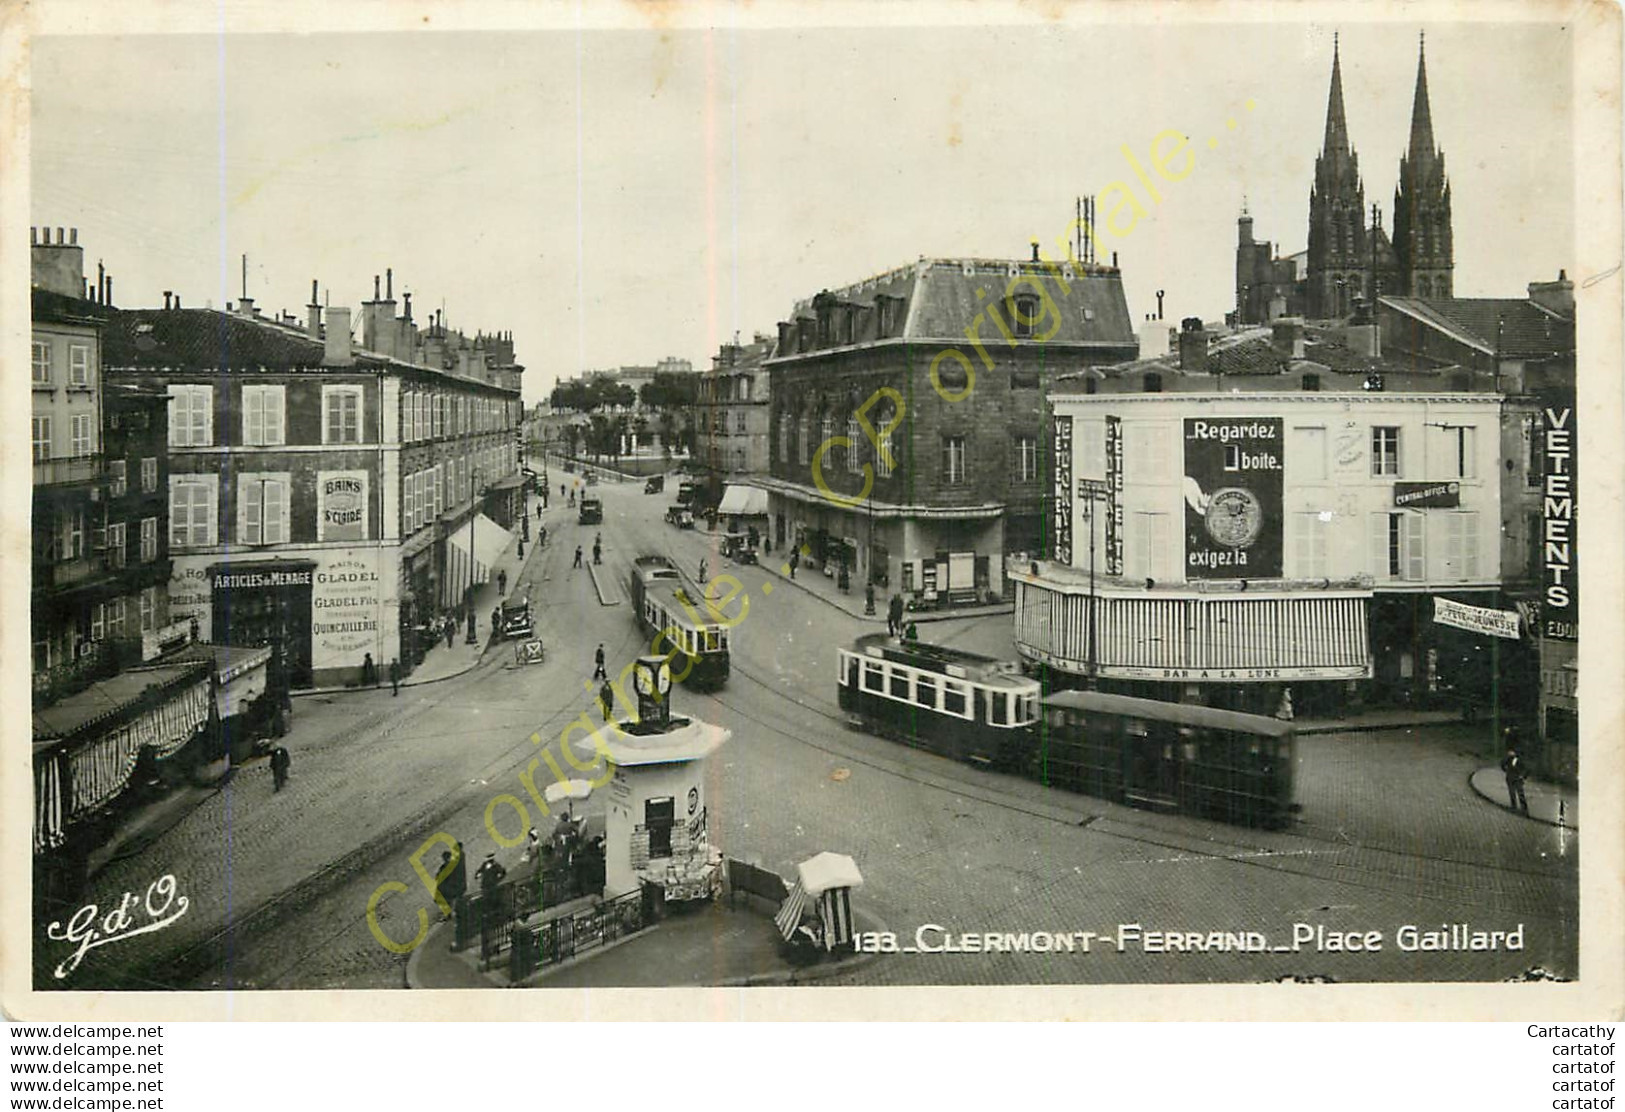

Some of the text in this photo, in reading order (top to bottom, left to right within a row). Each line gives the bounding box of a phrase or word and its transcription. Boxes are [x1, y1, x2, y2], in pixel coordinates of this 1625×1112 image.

[326, 480, 361, 495] BAINS
[1545, 408, 1571, 607] VETEMENTS
[1189, 549, 1247, 568] exigez la
[214, 574, 263, 589] ARTICLES
[271, 571, 311, 586] MENAGE
[317, 572, 379, 583] GLADEL
[314, 597, 358, 608] GLADEL
[313, 621, 378, 635] QUINCAILLERIE
[1473, 614, 1517, 632] JEUNESSE
[1163, 669, 1281, 678] BAR A LA LUNE
